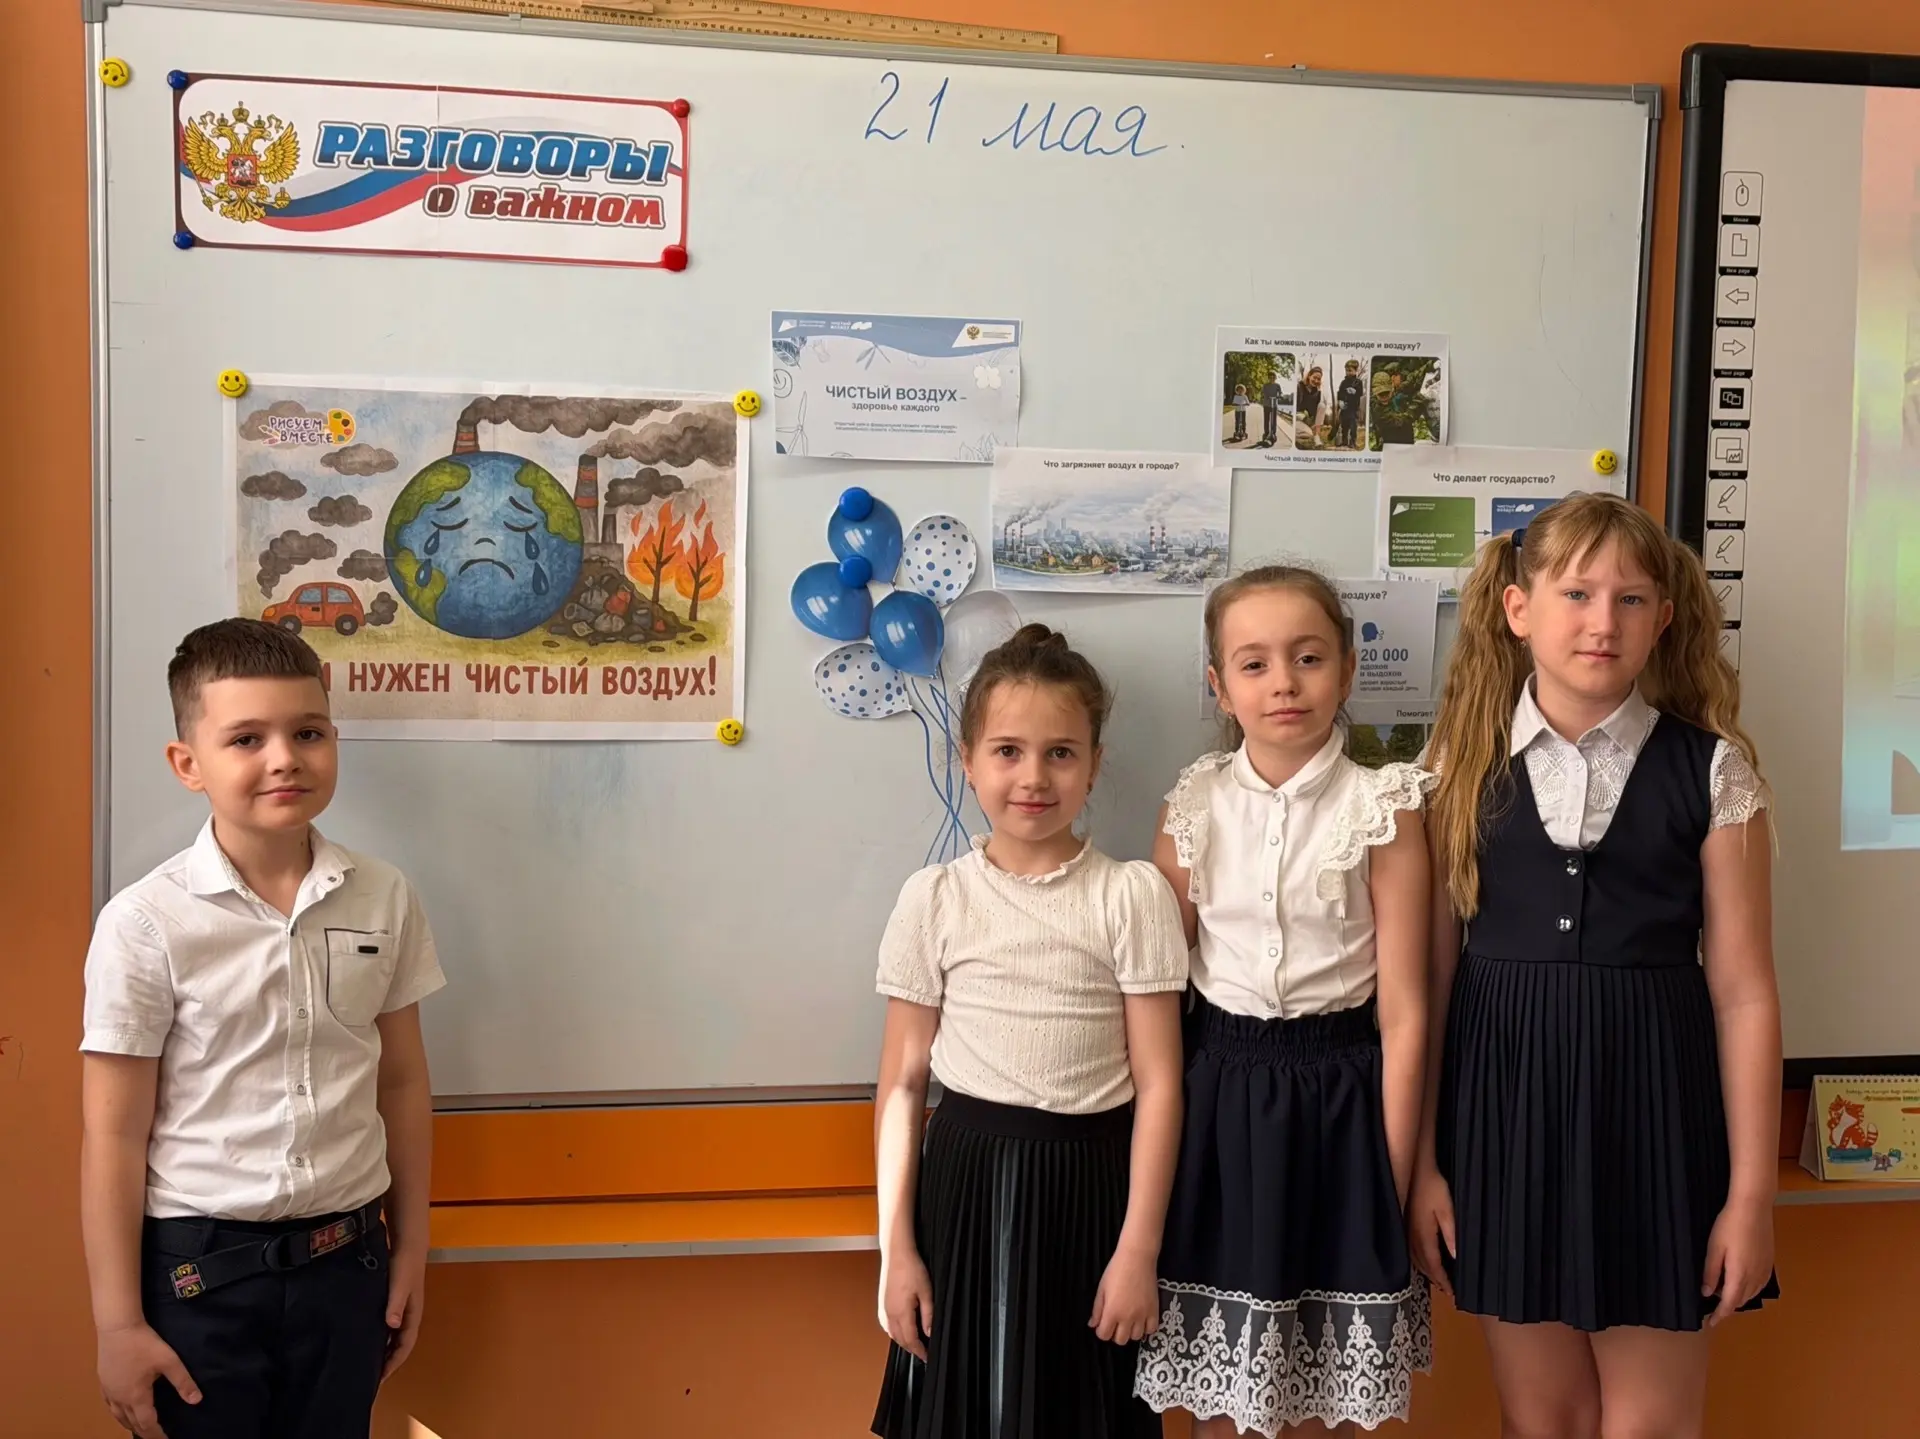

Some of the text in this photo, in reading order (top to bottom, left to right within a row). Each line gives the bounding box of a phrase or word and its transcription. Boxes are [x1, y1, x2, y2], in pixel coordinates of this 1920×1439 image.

[864, 72, 949, 144] 21
[314, 121, 672, 184] РАЗГОВОРЫ
[423, 184, 665, 230] о важном
[1244, 337, 1259, 346] Как
[1274, 339, 1307, 347] можешь
[1309, 340, 1339, 348] помочь
[1340, 341, 1375, 350] природе
[1384, 342, 1421, 351] воздуху?
[825, 385, 891, 400] ЧИСТЫЙ
[896, 387, 958, 403] ВОЗДУХ
[851, 402, 940, 412] здоровье каждого
[269, 416, 323, 431] РИСУЕМ
[280, 431, 334, 444] ВМЕСТЕ
[1043, 460, 1059, 468] Что
[1061, 461, 1105, 470] загрязняет
[1107, 462, 1137, 471] воздух
[1146, 462, 1180, 470] городе?
[1433, 472, 1556, 486] Что делает государство?
[1341, 590, 1388, 602] воздухе?
[1360, 648, 1409, 662] 20 000
[348, 661, 450, 694] НУЖЕН
[465, 656, 588, 695] ЧИСТЫЙ
[602, 655, 717, 701] ВОЗДУХ!
[1396, 709, 1434, 718] Помогает
